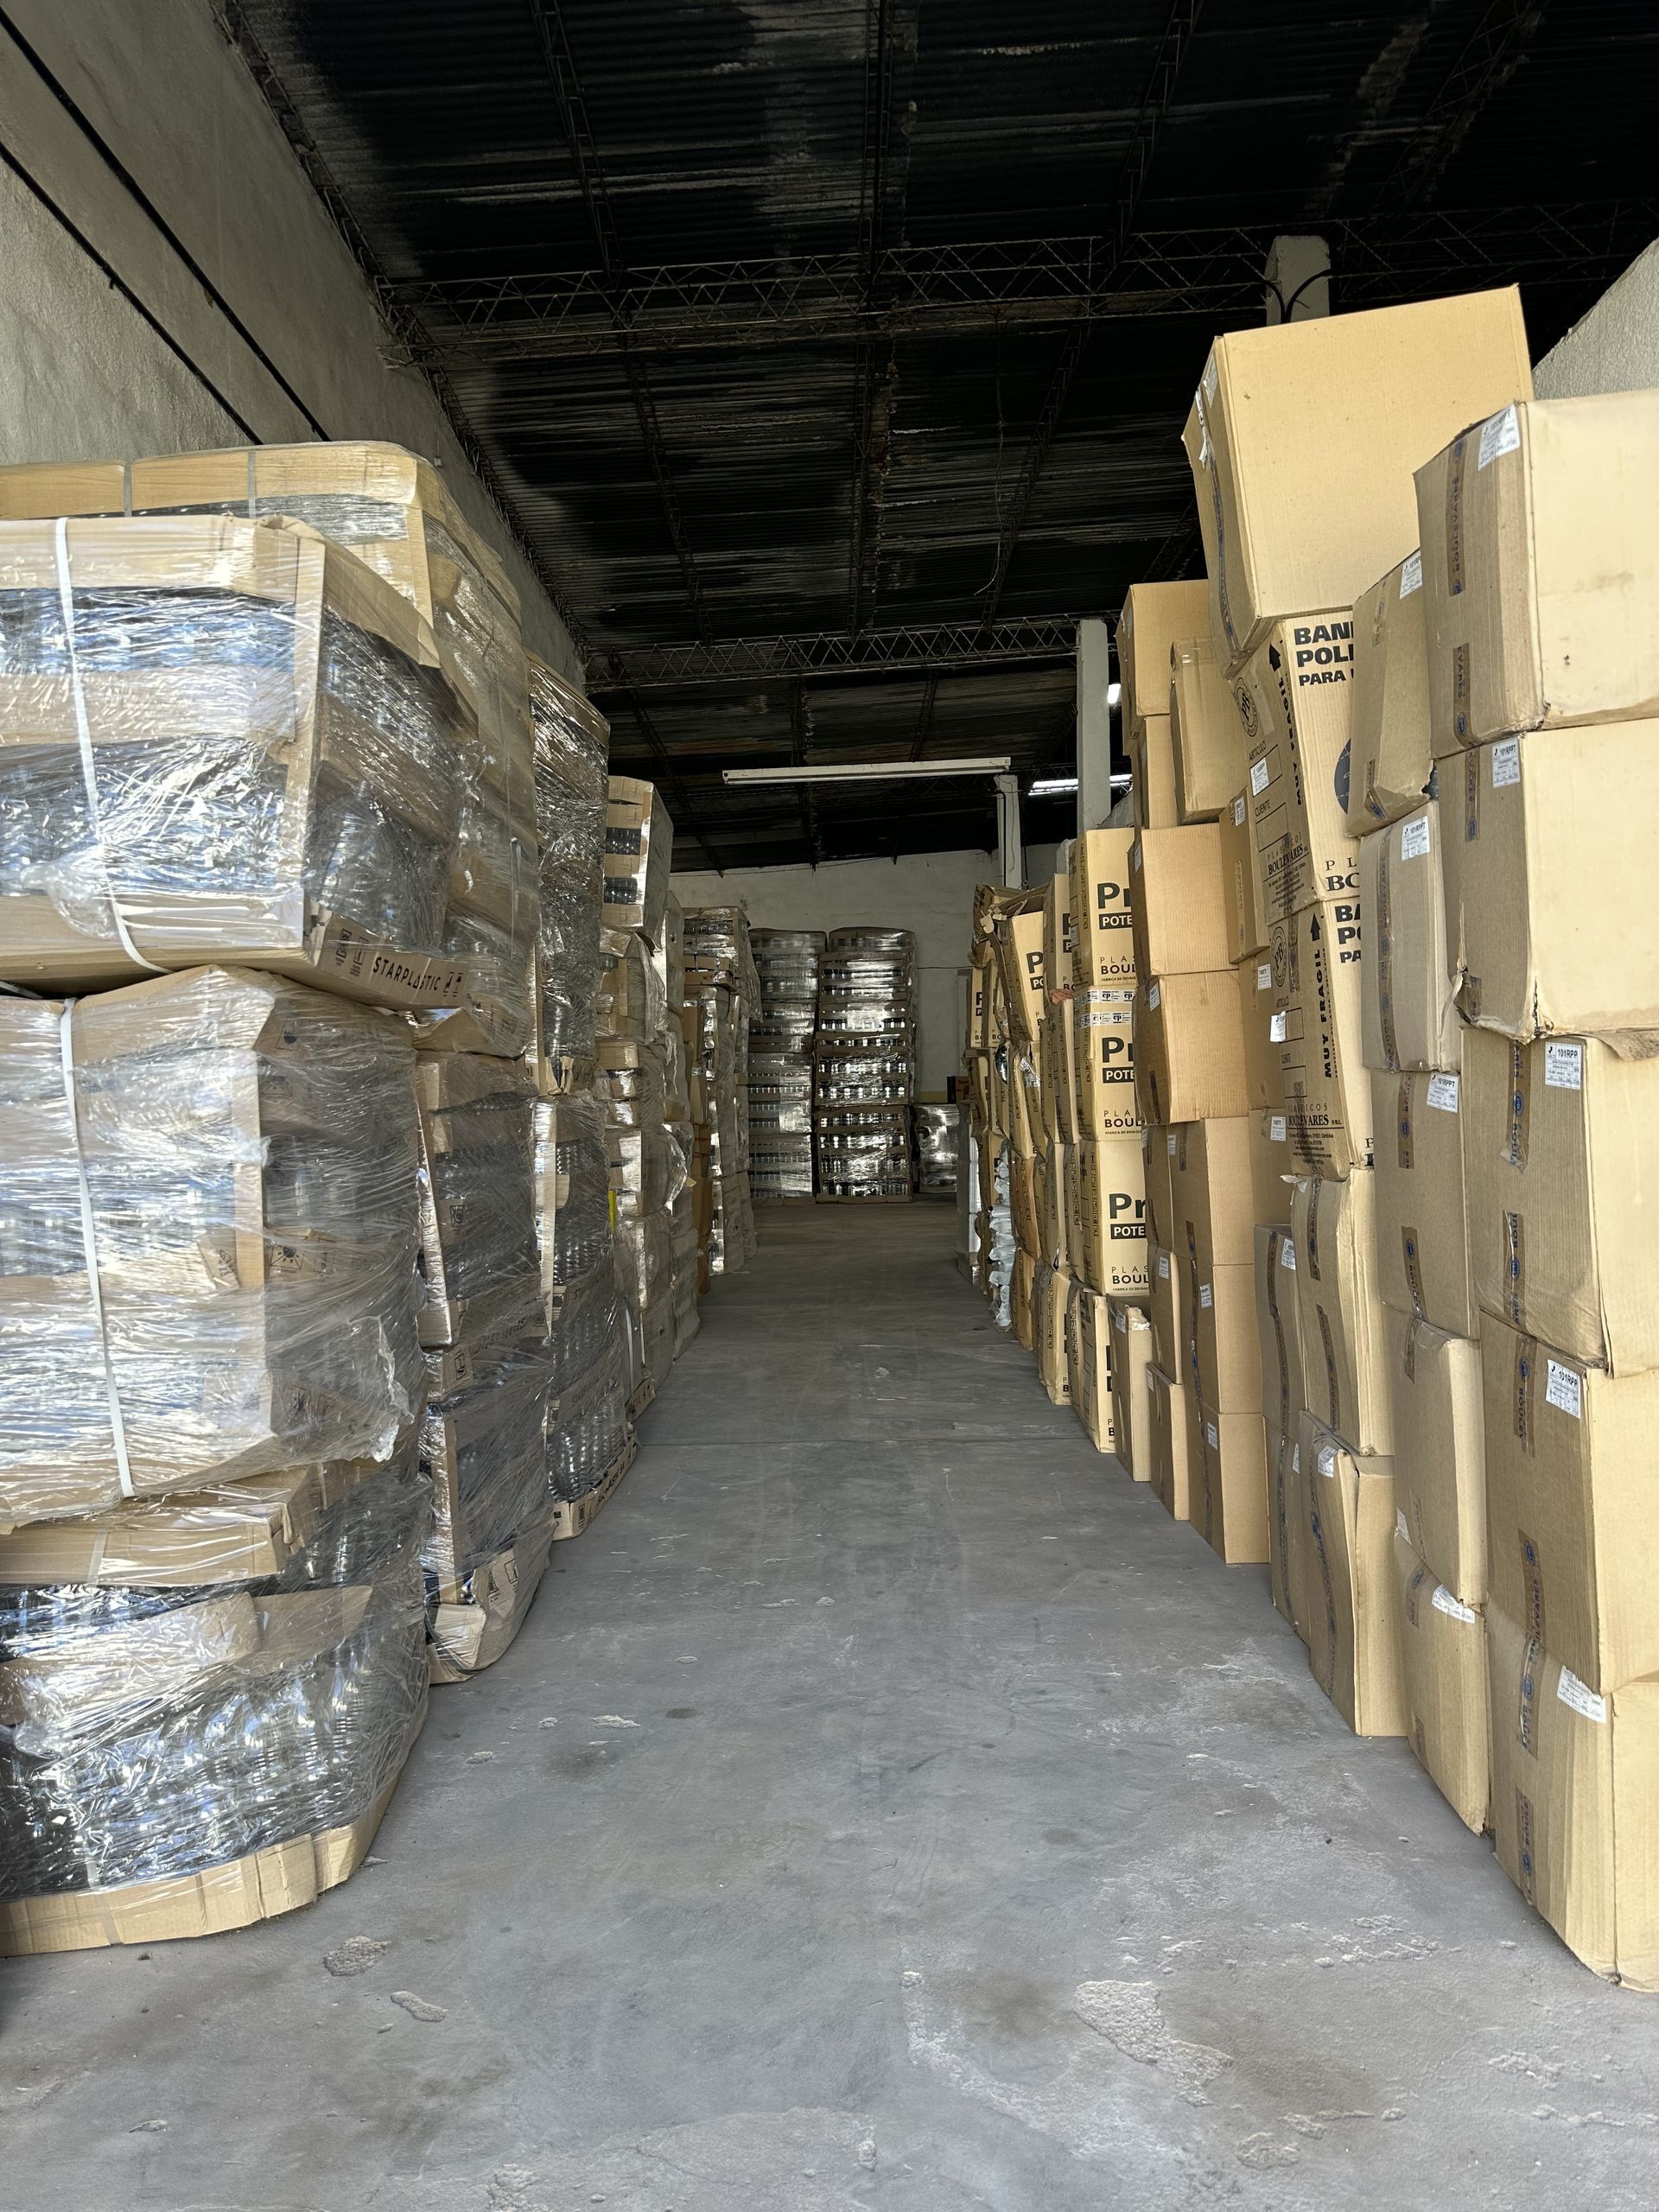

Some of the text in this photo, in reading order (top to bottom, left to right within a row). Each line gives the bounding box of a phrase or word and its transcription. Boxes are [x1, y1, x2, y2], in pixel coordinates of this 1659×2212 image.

[1299, 670, 1346, 687] PARA
[1279, 677, 1295, 751] FRAGIL
[1268, 843, 1305, 875] BOULEVARES
[372, 957, 442, 991] STARPLASTIC
[1314, 949, 1332, 1078] MUY FRAGIL
[1557, 1048, 1579, 1058] 101RPP
[1114, 1225, 1145, 1237] POTE
[1112, 1274, 1149, 1285] BOUL
[1559, 1370, 1579, 1387] 101RPP
